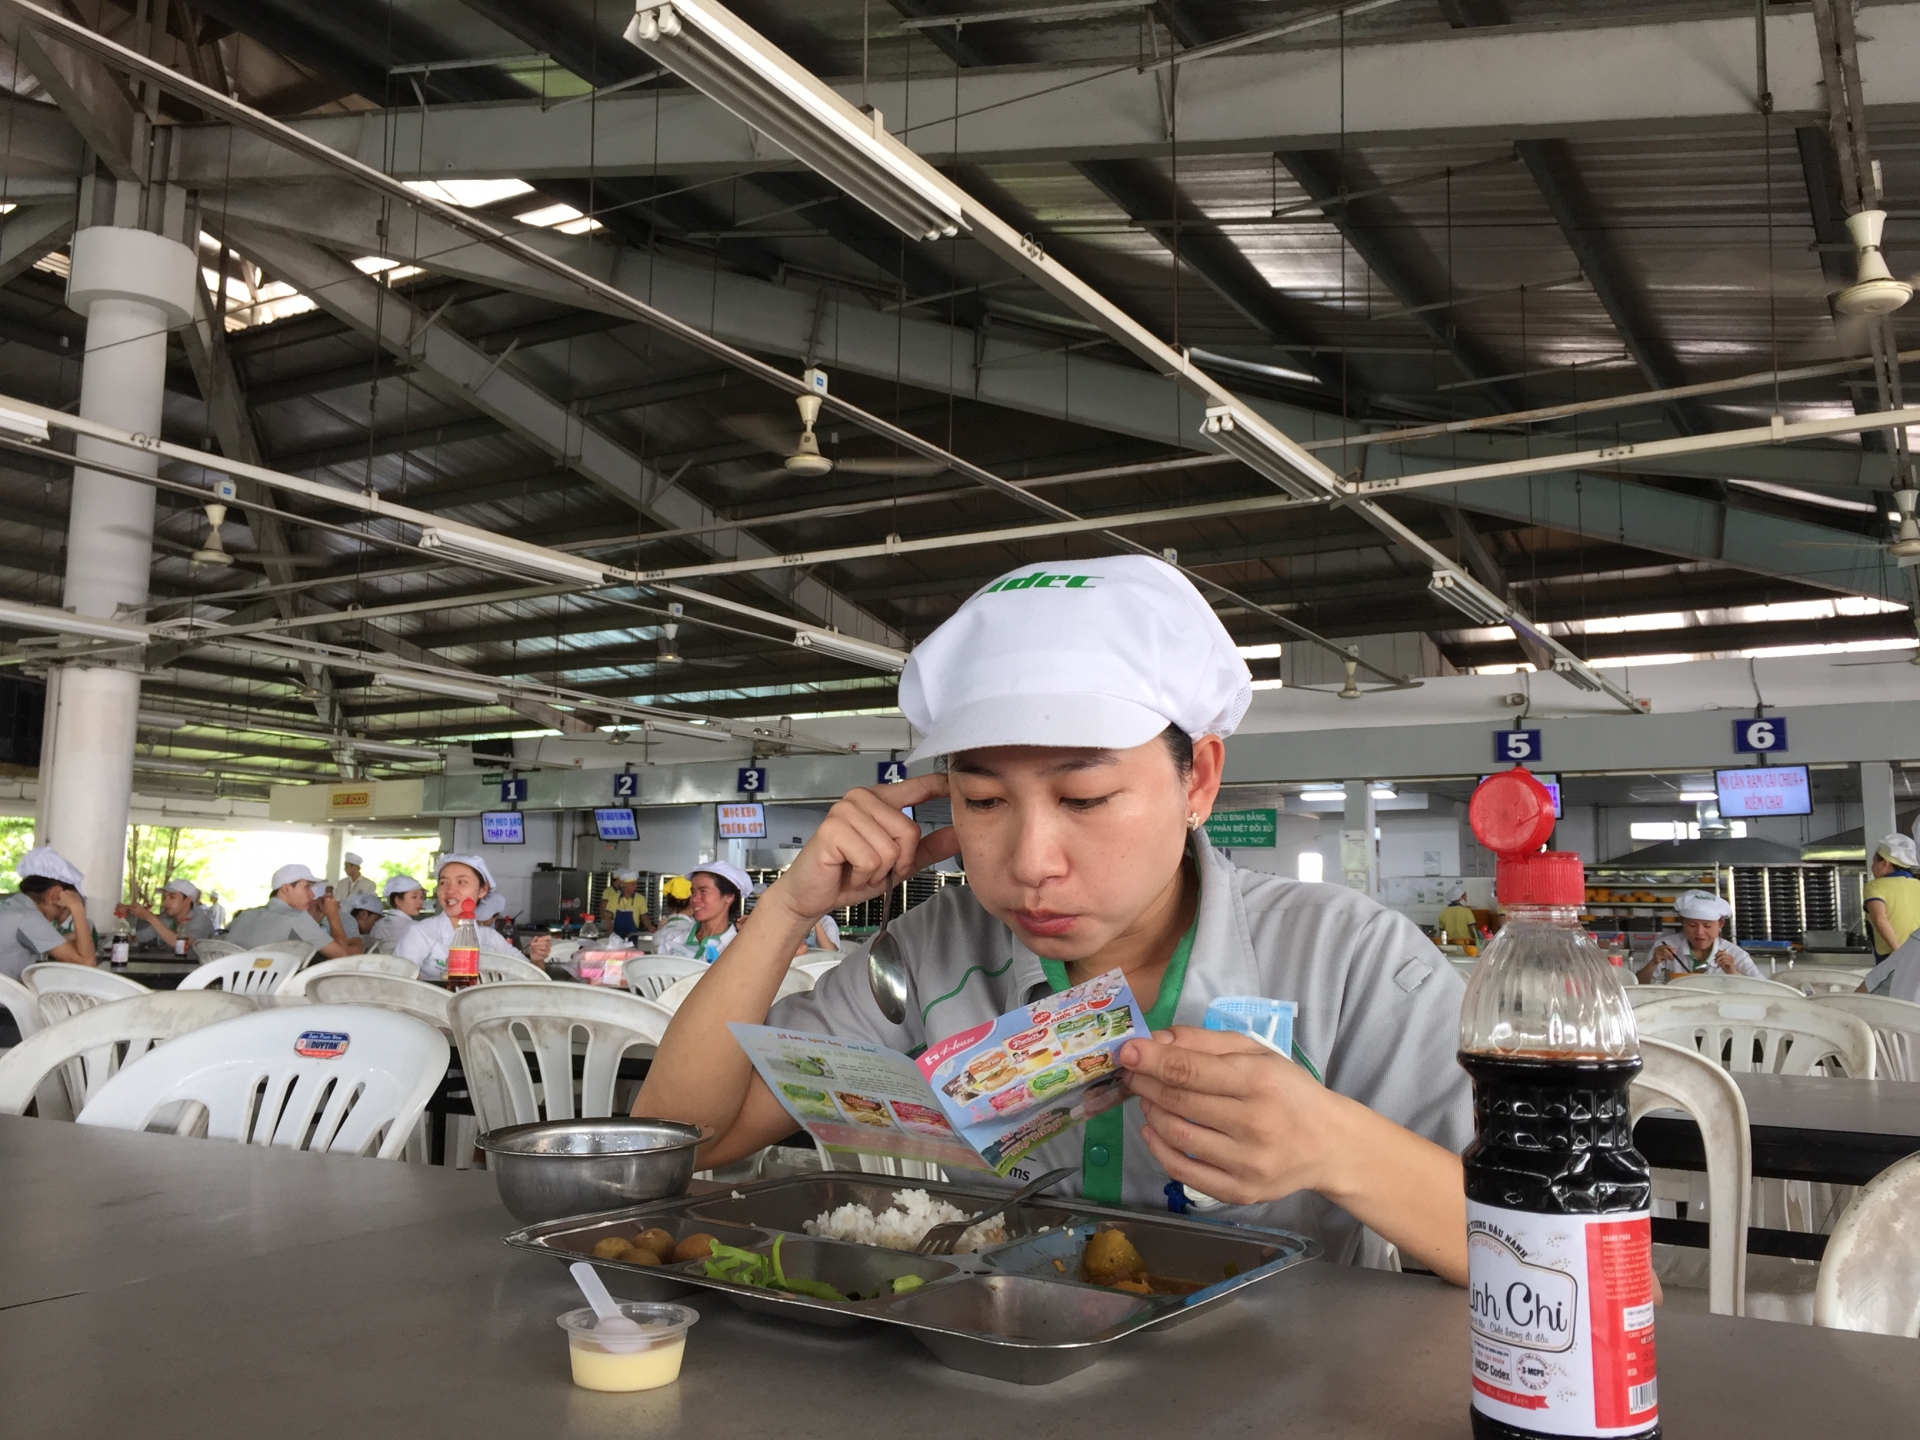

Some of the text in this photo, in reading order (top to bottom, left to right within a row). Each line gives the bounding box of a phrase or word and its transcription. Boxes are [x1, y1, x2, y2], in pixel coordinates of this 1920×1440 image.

[974, 571, 1105, 599] idec
[1747, 722, 1775, 749] 6
[1506, 733, 1531, 759] 5
[744, 771, 758, 789] 3
[884, 764, 900, 783] 4
[507, 781, 518, 800] 1
[619, 776, 632, 795] 2
[1233, 823, 1248, 833] BIỆT
[1232, 836, 1247, 844] SAY
[940, 1036, 975, 1056] House
[1506, 1282, 1568, 1332] Chi
[1490, 1365, 1510, 1381] Codex
